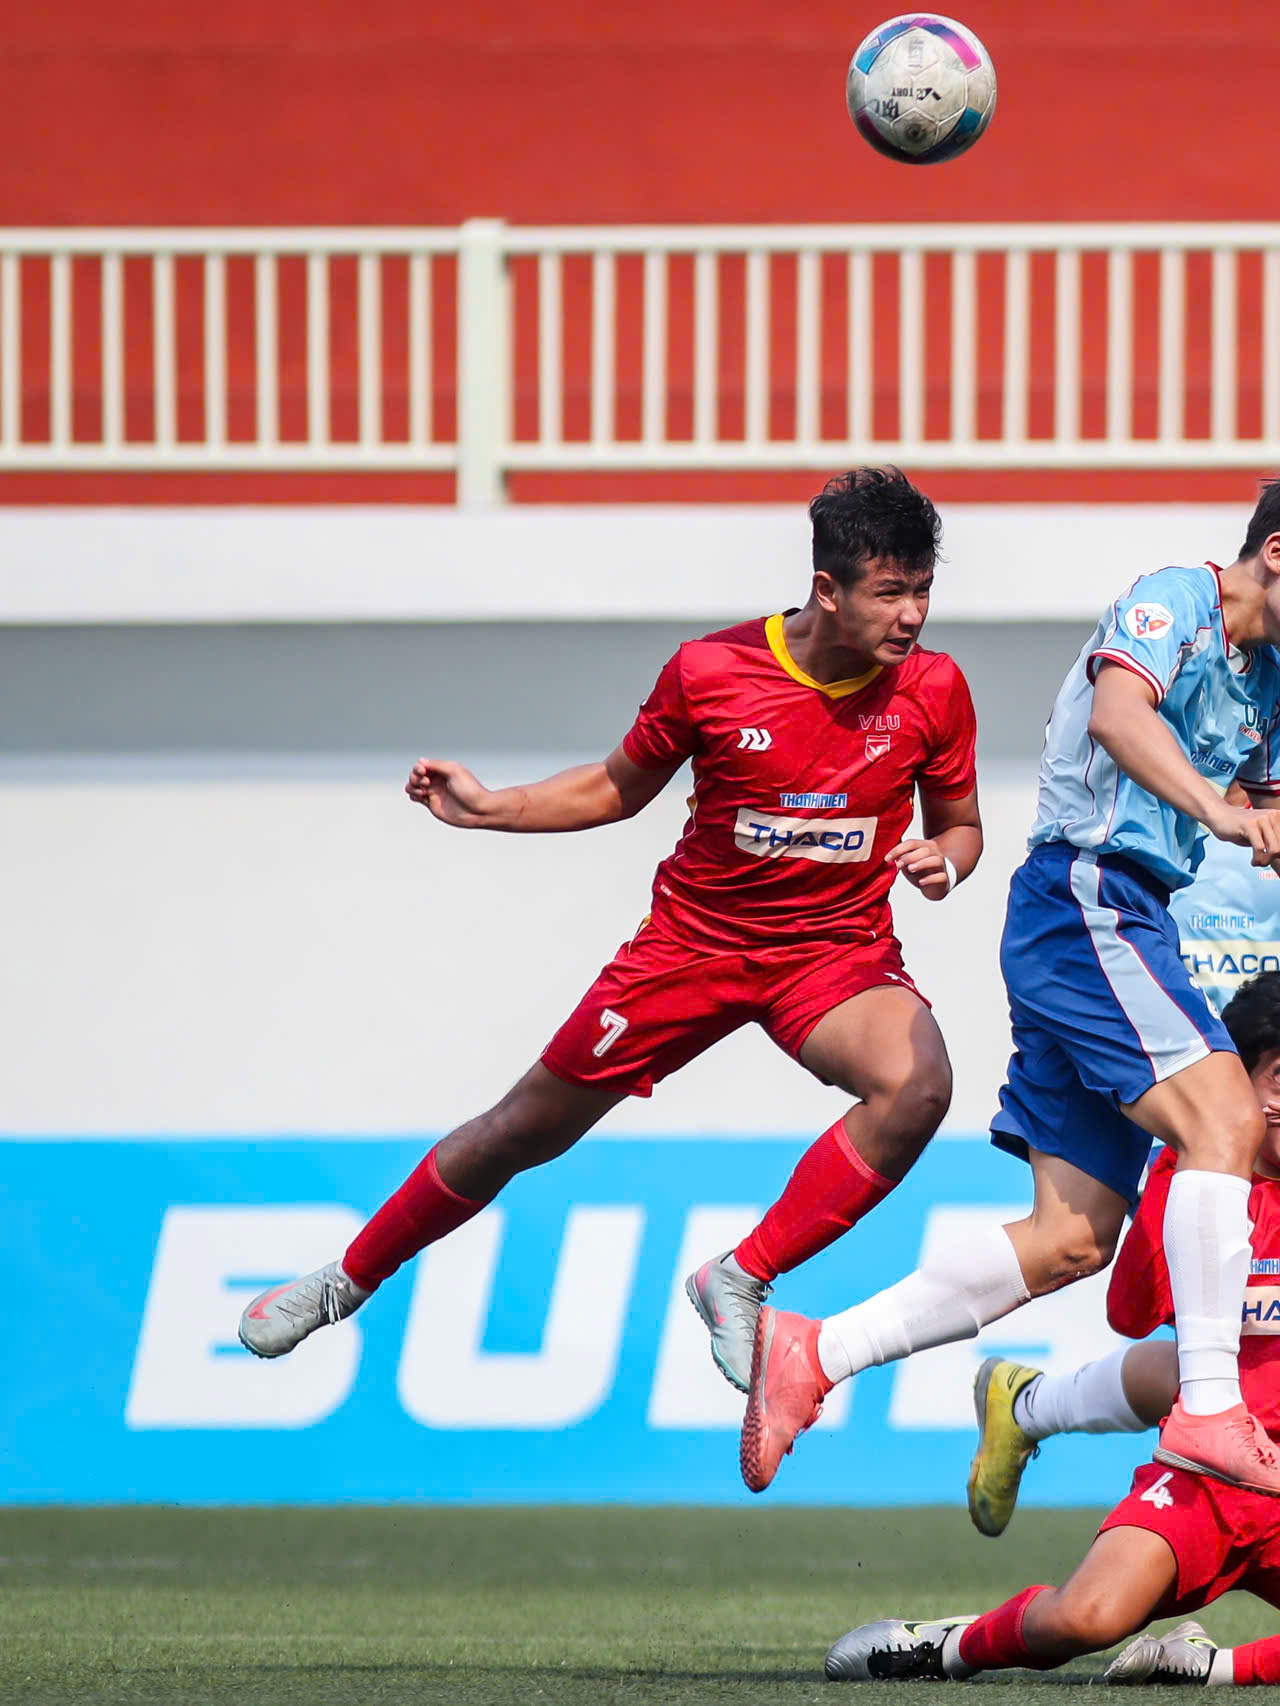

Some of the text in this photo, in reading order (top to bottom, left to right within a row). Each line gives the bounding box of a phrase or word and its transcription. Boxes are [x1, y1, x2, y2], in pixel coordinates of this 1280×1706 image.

[858, 714, 901, 731] VLU
[780, 793, 819, 808] THANH
[748, 822, 865, 851] THACO
[1191, 913, 1229, 929] THANH
[592, 1008, 629, 1058] 7
[1249, 1259, 1279, 1274] HANH
[1140, 1471, 1174, 1510] 4
